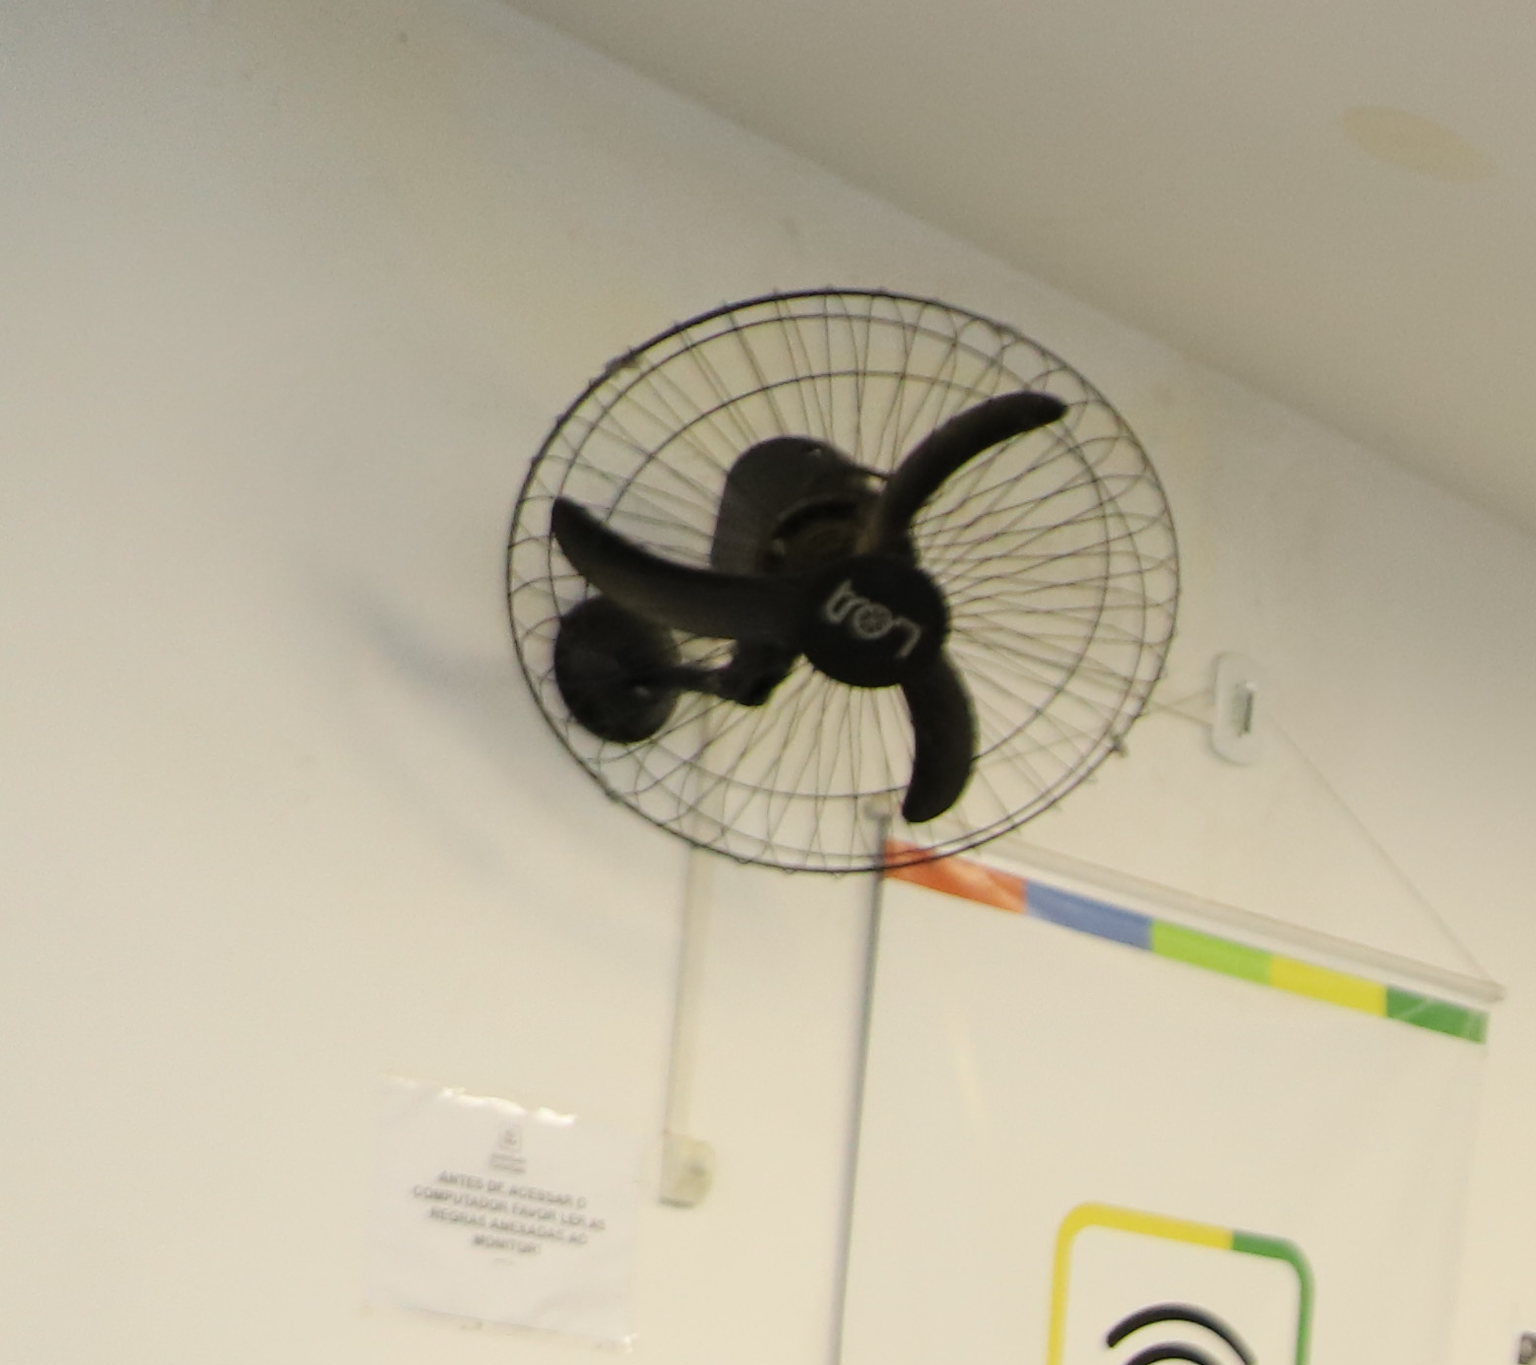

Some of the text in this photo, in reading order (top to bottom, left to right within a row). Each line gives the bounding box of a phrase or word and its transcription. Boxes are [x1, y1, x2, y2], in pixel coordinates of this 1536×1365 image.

[439, 1170, 483, 1190] ANTES
[487, 1179, 504, 1193] DE
[509, 1185, 573, 1206] ACESSAR
[413, 1185, 508, 1211] COMPUTADOR
[512, 1202, 557, 1221] FAVOR
[561, 1212, 587, 1226] LER
[430, 1206, 486, 1227] REGRAS
[473, 1234, 540, 1254] MONITOR
